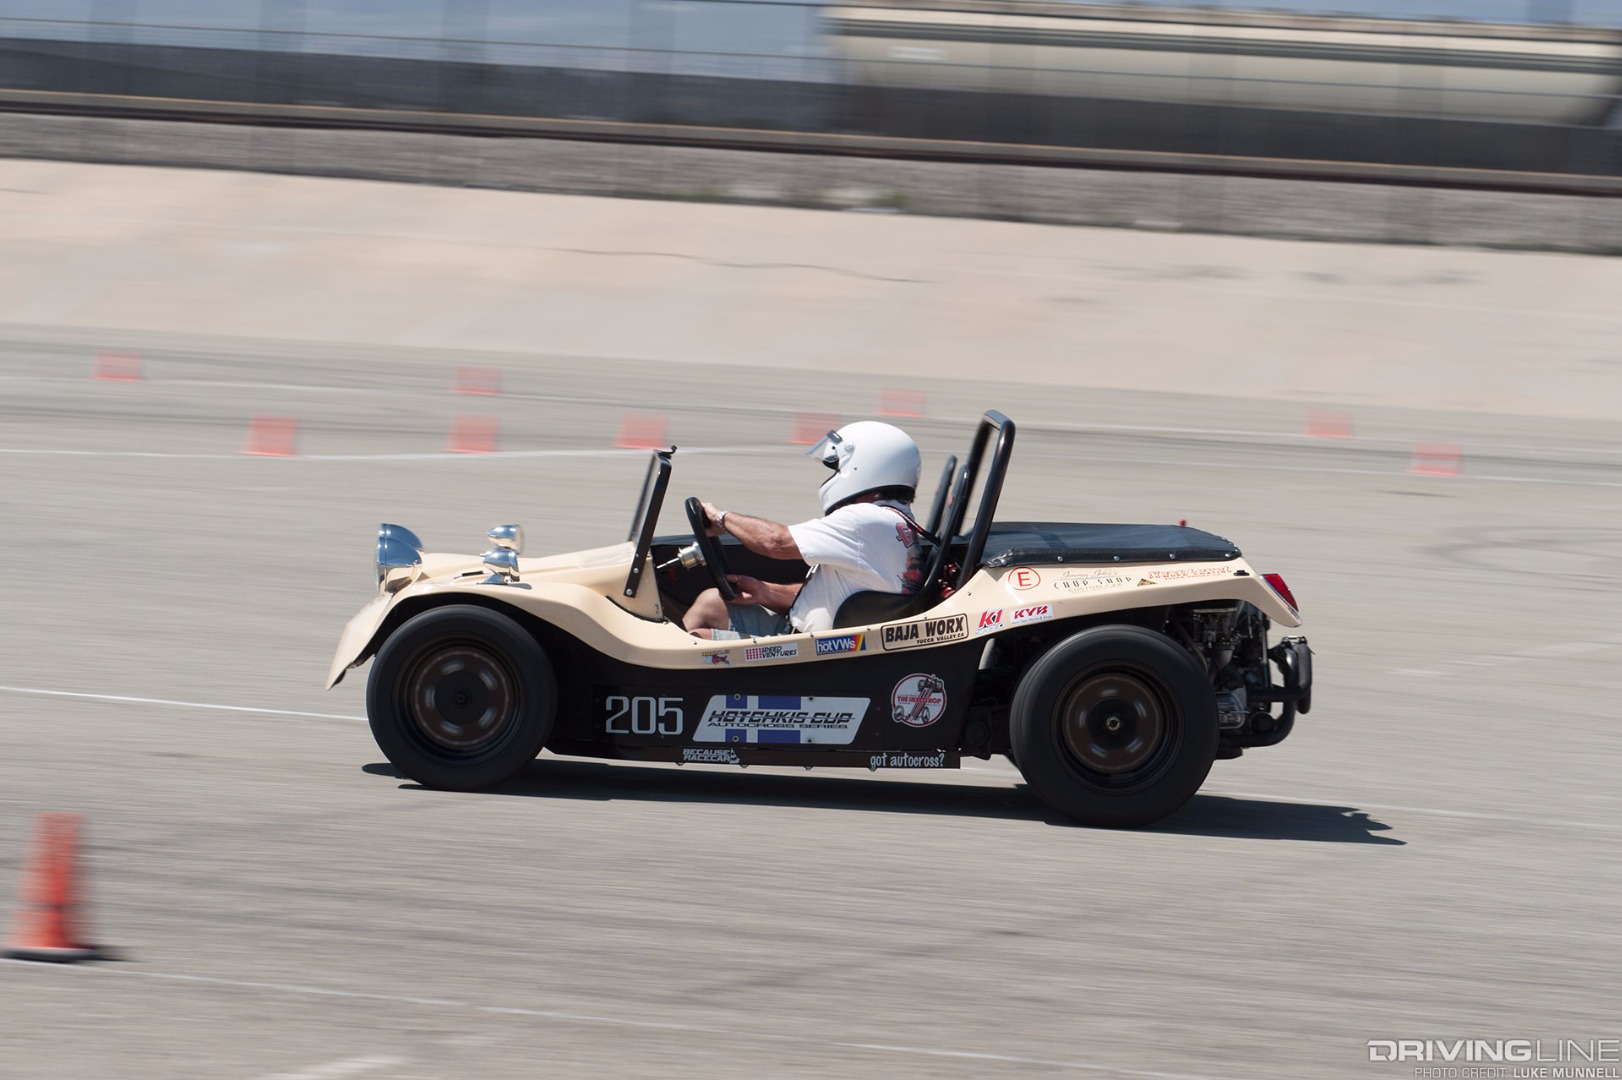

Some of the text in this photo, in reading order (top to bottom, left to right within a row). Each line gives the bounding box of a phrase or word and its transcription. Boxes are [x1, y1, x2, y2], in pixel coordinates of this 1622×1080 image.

[1017, 571, 1031, 587] E
[1014, 605, 1048, 619] KYB
[886, 624, 919, 643] BAJA
[925, 617, 964, 637] WORX
[762, 646, 782, 654] SPEED
[762, 649, 797, 658] VENTURES
[605, 695, 684, 735] 205
[708, 710, 853, 724] HOTCHKIS CUP
[683, 748, 730, 756] BECAUSE
[870, 752, 945, 768] got autocross?
